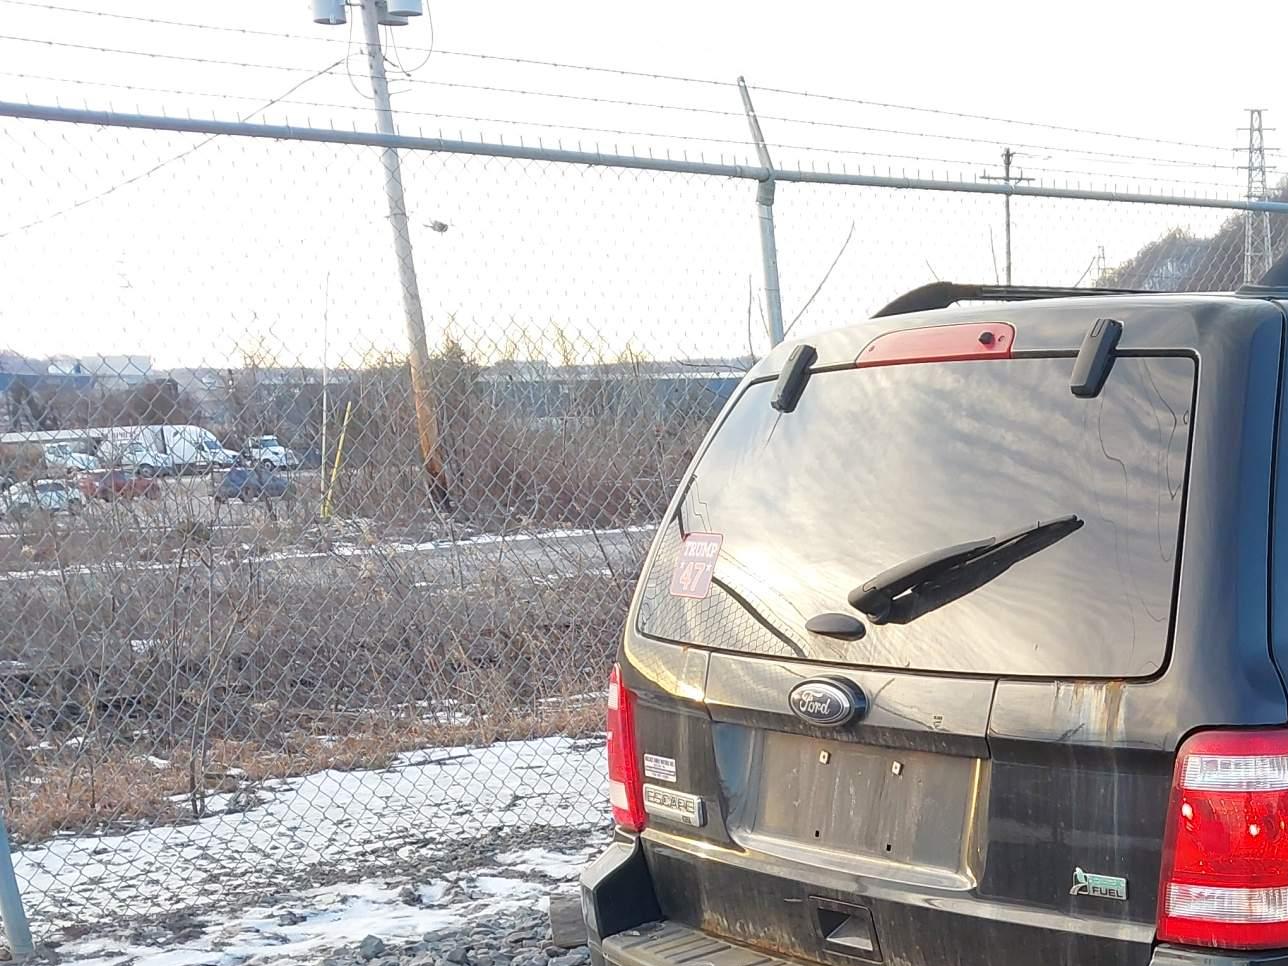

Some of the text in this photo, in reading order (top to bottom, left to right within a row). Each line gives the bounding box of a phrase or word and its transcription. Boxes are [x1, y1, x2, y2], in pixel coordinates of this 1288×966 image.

[683, 541, 717, 558] TRUMP
[799, 690, 831, 715] Ford
[647, 789, 695, 813] ESCAPE
[1092, 886, 1124, 898] FUEL
